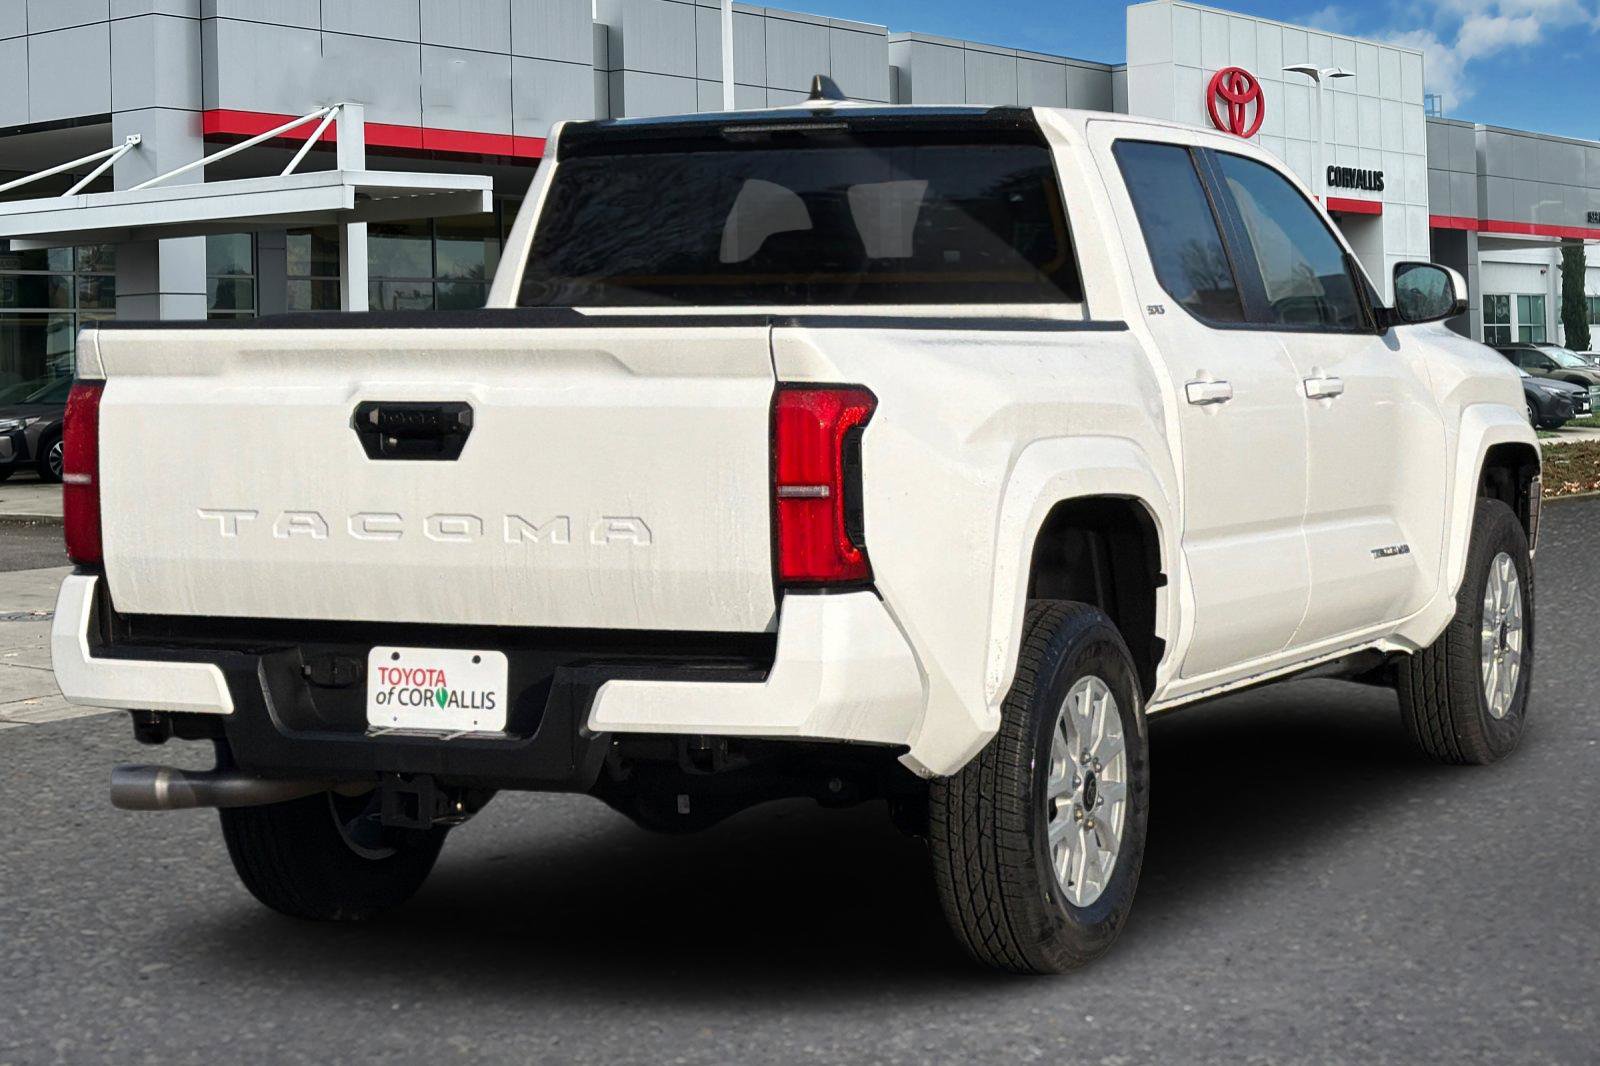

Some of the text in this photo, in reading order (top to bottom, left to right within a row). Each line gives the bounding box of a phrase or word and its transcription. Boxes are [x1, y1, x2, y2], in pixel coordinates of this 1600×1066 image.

[1327, 165, 1384, 192] CORVALLIS
[197, 508, 653, 546] TACOMA
[378, 667, 447, 687] TOYOTA
[375, 686, 396, 705] of
